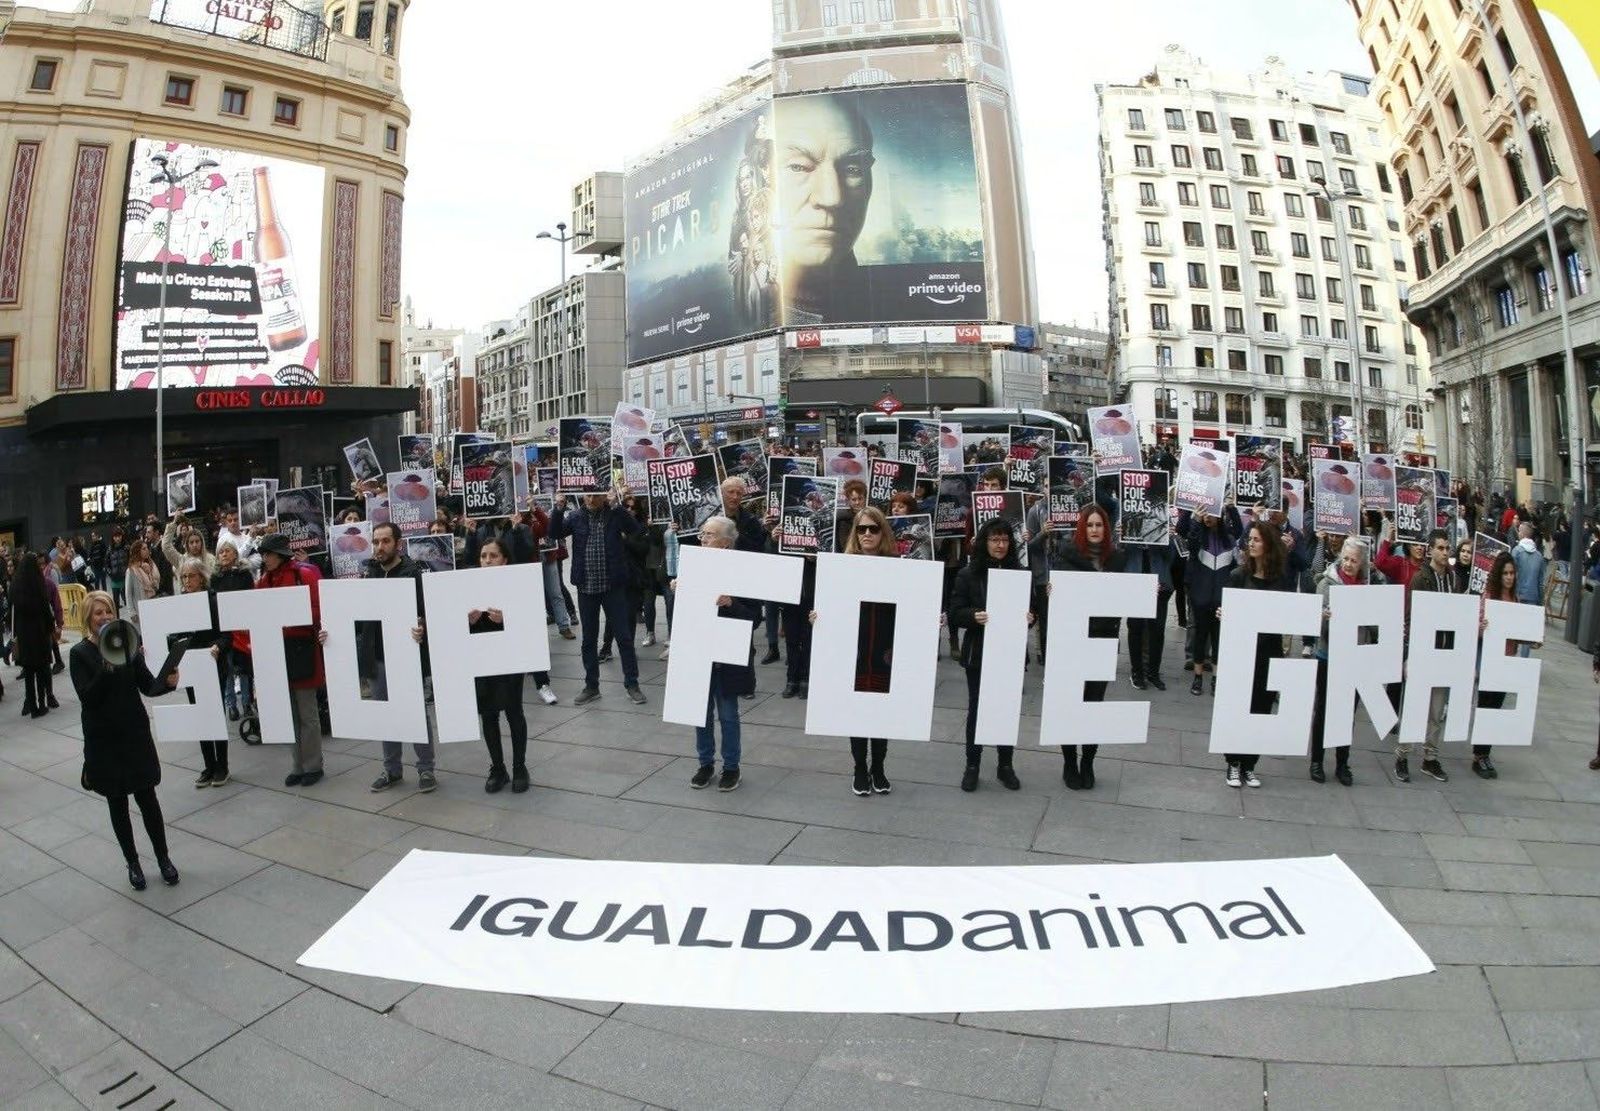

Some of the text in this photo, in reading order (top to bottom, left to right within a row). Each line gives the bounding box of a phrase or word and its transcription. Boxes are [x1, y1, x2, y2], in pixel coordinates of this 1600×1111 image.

[206, 0, 283, 30] CALLAO
[634, 153, 714, 199] AMAZON ORIGINAL
[651, 189, 691, 223] STAR TREK
[632, 200, 720, 267] PICARD
[175, 273, 206, 286] Cinco
[207, 275, 252, 289] Estrellas
[928, 273, 960, 281] amazon
[191, 288, 252, 302] Session IPA
[909, 282, 981, 297] prime video
[146, 329, 182, 337] MAETROS
[196, 389, 325, 409] CINES CALLAO
[744, 409, 759, 419] AVIS
[1311, 447, 1328, 458] STOP
[562, 457, 588, 467] EL FOIE
[649, 462, 663, 474] ST
[874, 462, 900, 475] STOP
[1012, 458, 1031, 471] OIE
[561, 466, 593, 476] GRAS ES
[667, 461, 695, 478] STOP
[561, 476, 596, 486] TORTURA
[651, 474, 663, 486] FO
[872, 475, 894, 488] FOIE
[1011, 470, 1036, 484] GRAS
[1123, 472, 1150, 486] STOP
[1237, 470, 1258, 484] FOIE
[465, 480, 489, 494] FOIE
[670, 476, 694, 493] FOIE
[744, 485, 761, 494] TURA
[1237, 483, 1264, 498] GRAS
[467, 493, 496, 508] GRAS
[672, 488, 702, 506] GRAS
[1124, 487, 1146, 500] FOIE
[976, 495, 1004, 509] STOP
[1051, 503, 1079, 512] GRAS ES
[1123, 499, 1152, 513] GRAS
[1051, 512, 1081, 521] TORTURA
[1398, 503, 1417, 518] FOIE
[399, 521, 430, 531] FERMEDAD
[785, 516, 810, 526] EL FOIE
[1398, 516, 1422, 531] GRAS
[784, 526, 816, 536] GRAS ES
[289, 538, 320, 550] FERMEDAD
[783, 535, 817, 546] TORTURA
[138, 545, 1545, 756] STOP FOIE GRAS
[450, 886, 1307, 954] IGUALDADanimal
